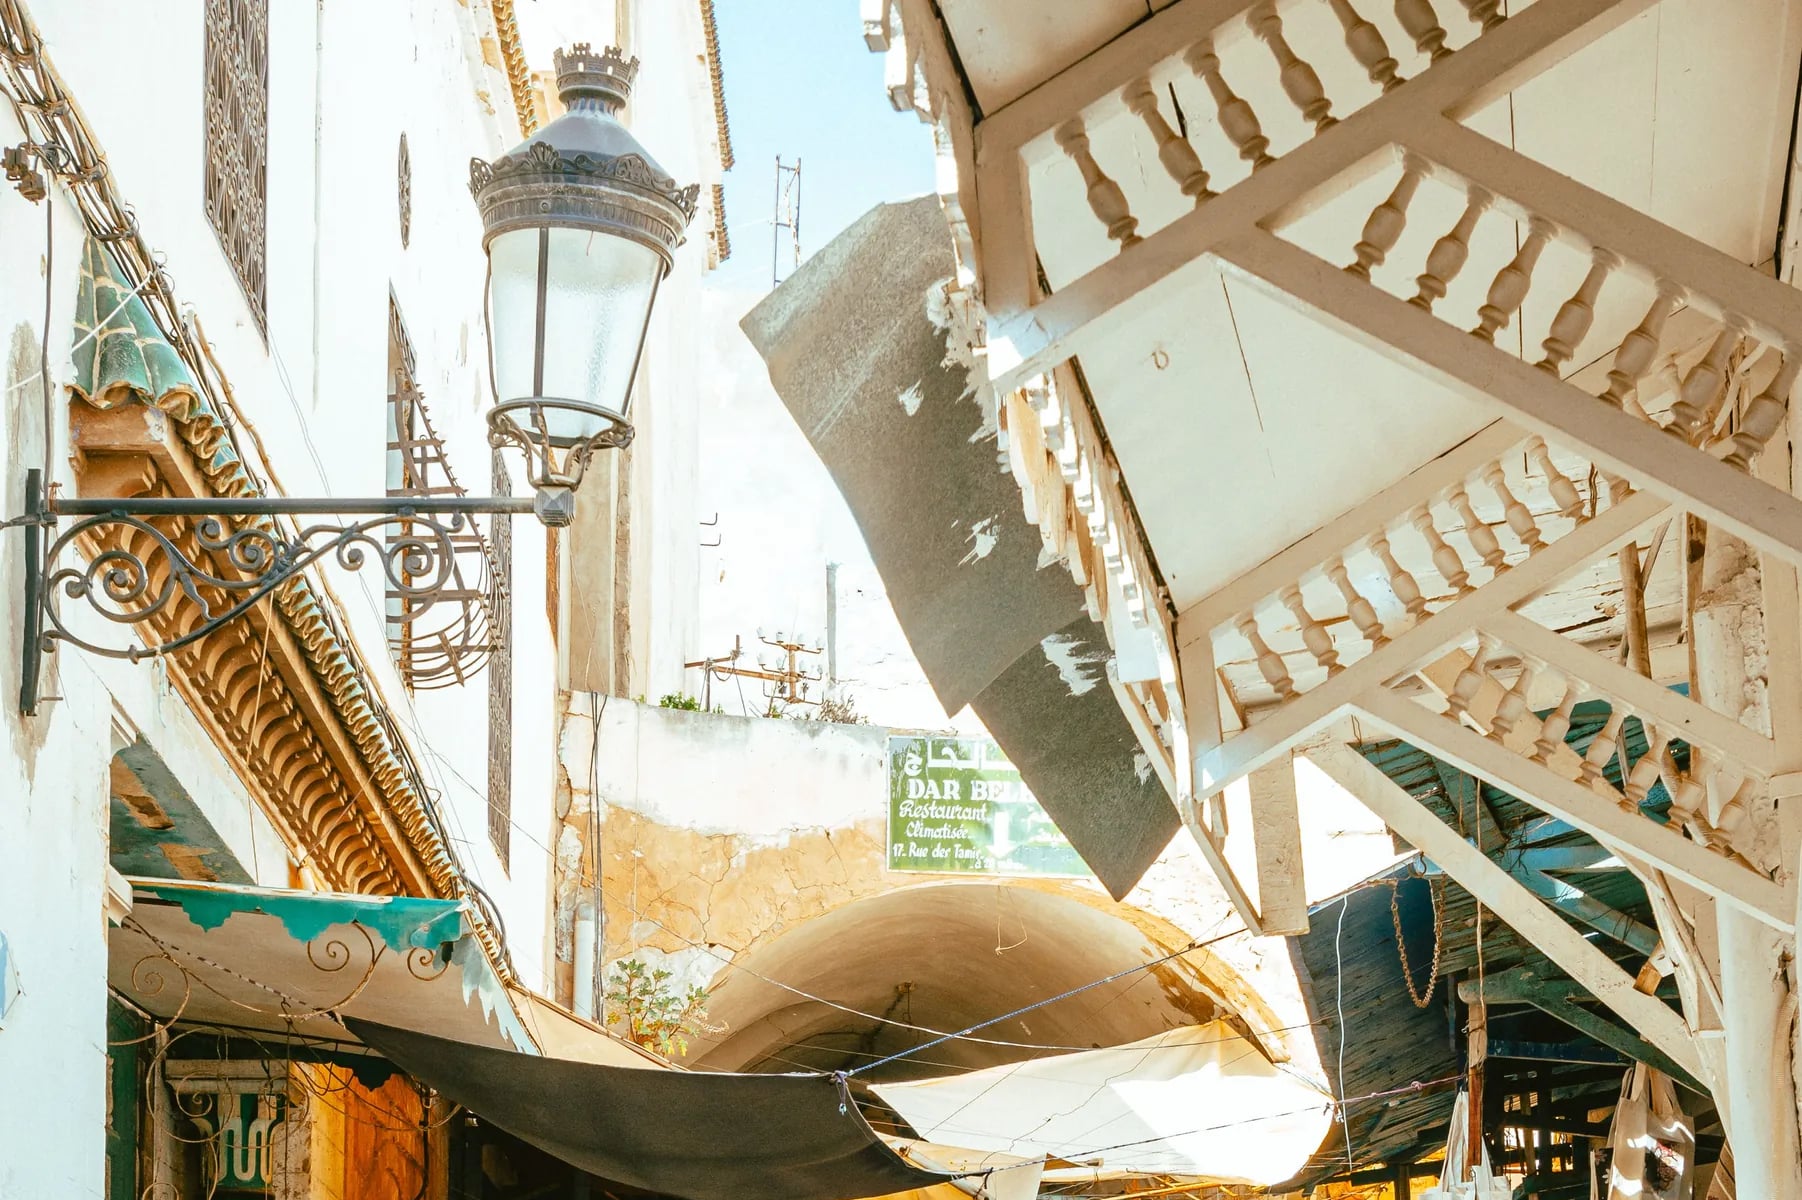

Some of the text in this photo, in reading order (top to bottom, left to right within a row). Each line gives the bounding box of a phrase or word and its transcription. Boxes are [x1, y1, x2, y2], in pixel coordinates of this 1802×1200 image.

[907, 779, 960, 800] DAR
[899, 800, 987, 820] Restaurant
[909, 842, 928, 858] Rue
